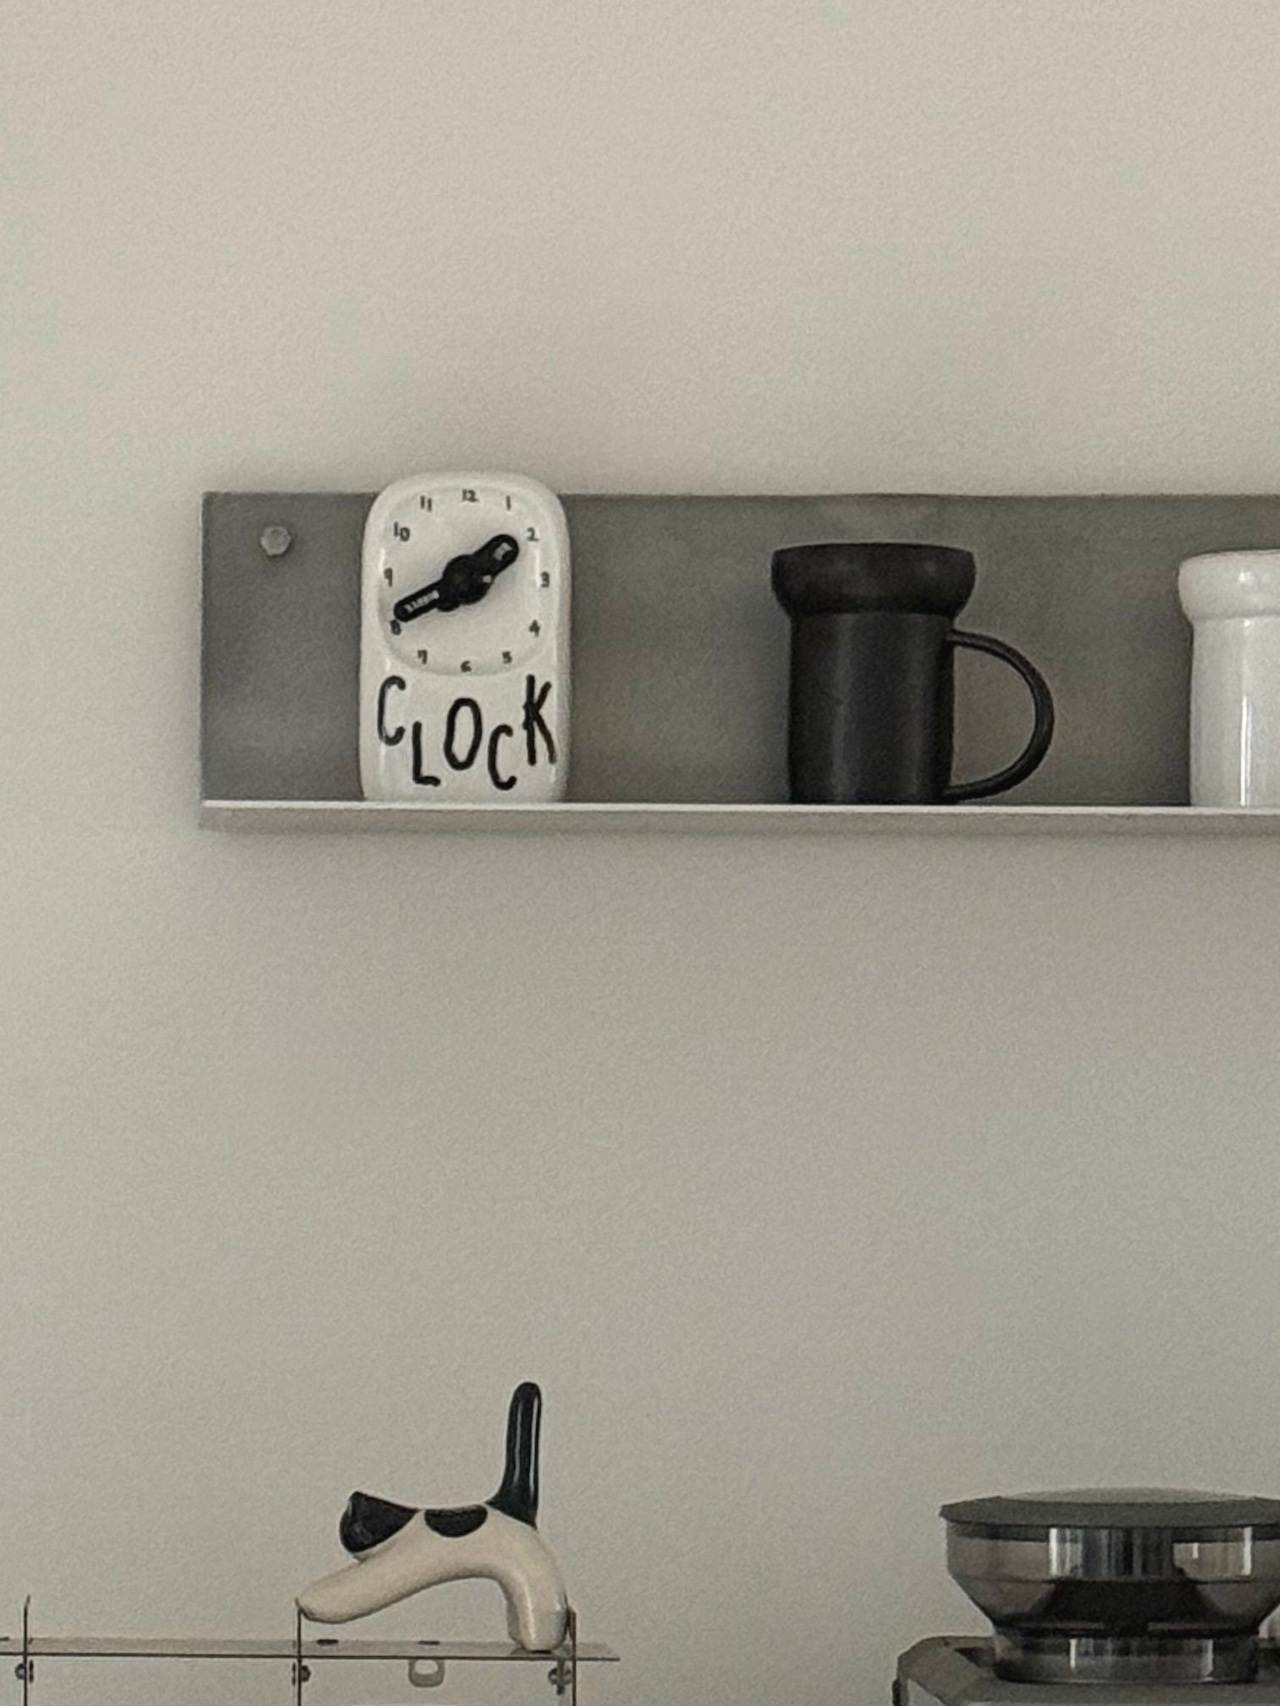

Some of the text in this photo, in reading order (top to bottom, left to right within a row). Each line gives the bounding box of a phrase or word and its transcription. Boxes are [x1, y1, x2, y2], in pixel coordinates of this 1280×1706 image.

[420, 495, 432, 512] 11
[462, 489, 478, 502] 12
[505, 495, 512, 511] 1
[393, 521, 411, 542] 10
[526, 527, 539, 542] 2
[540, 571, 550, 588] 3
[528, 619, 540, 637] 4
[418, 649, 428, 665] 7
[502, 651, 512, 665] 5
[460, 660, 472, 673] 6
[377, 675, 557, 790] CLOCK
